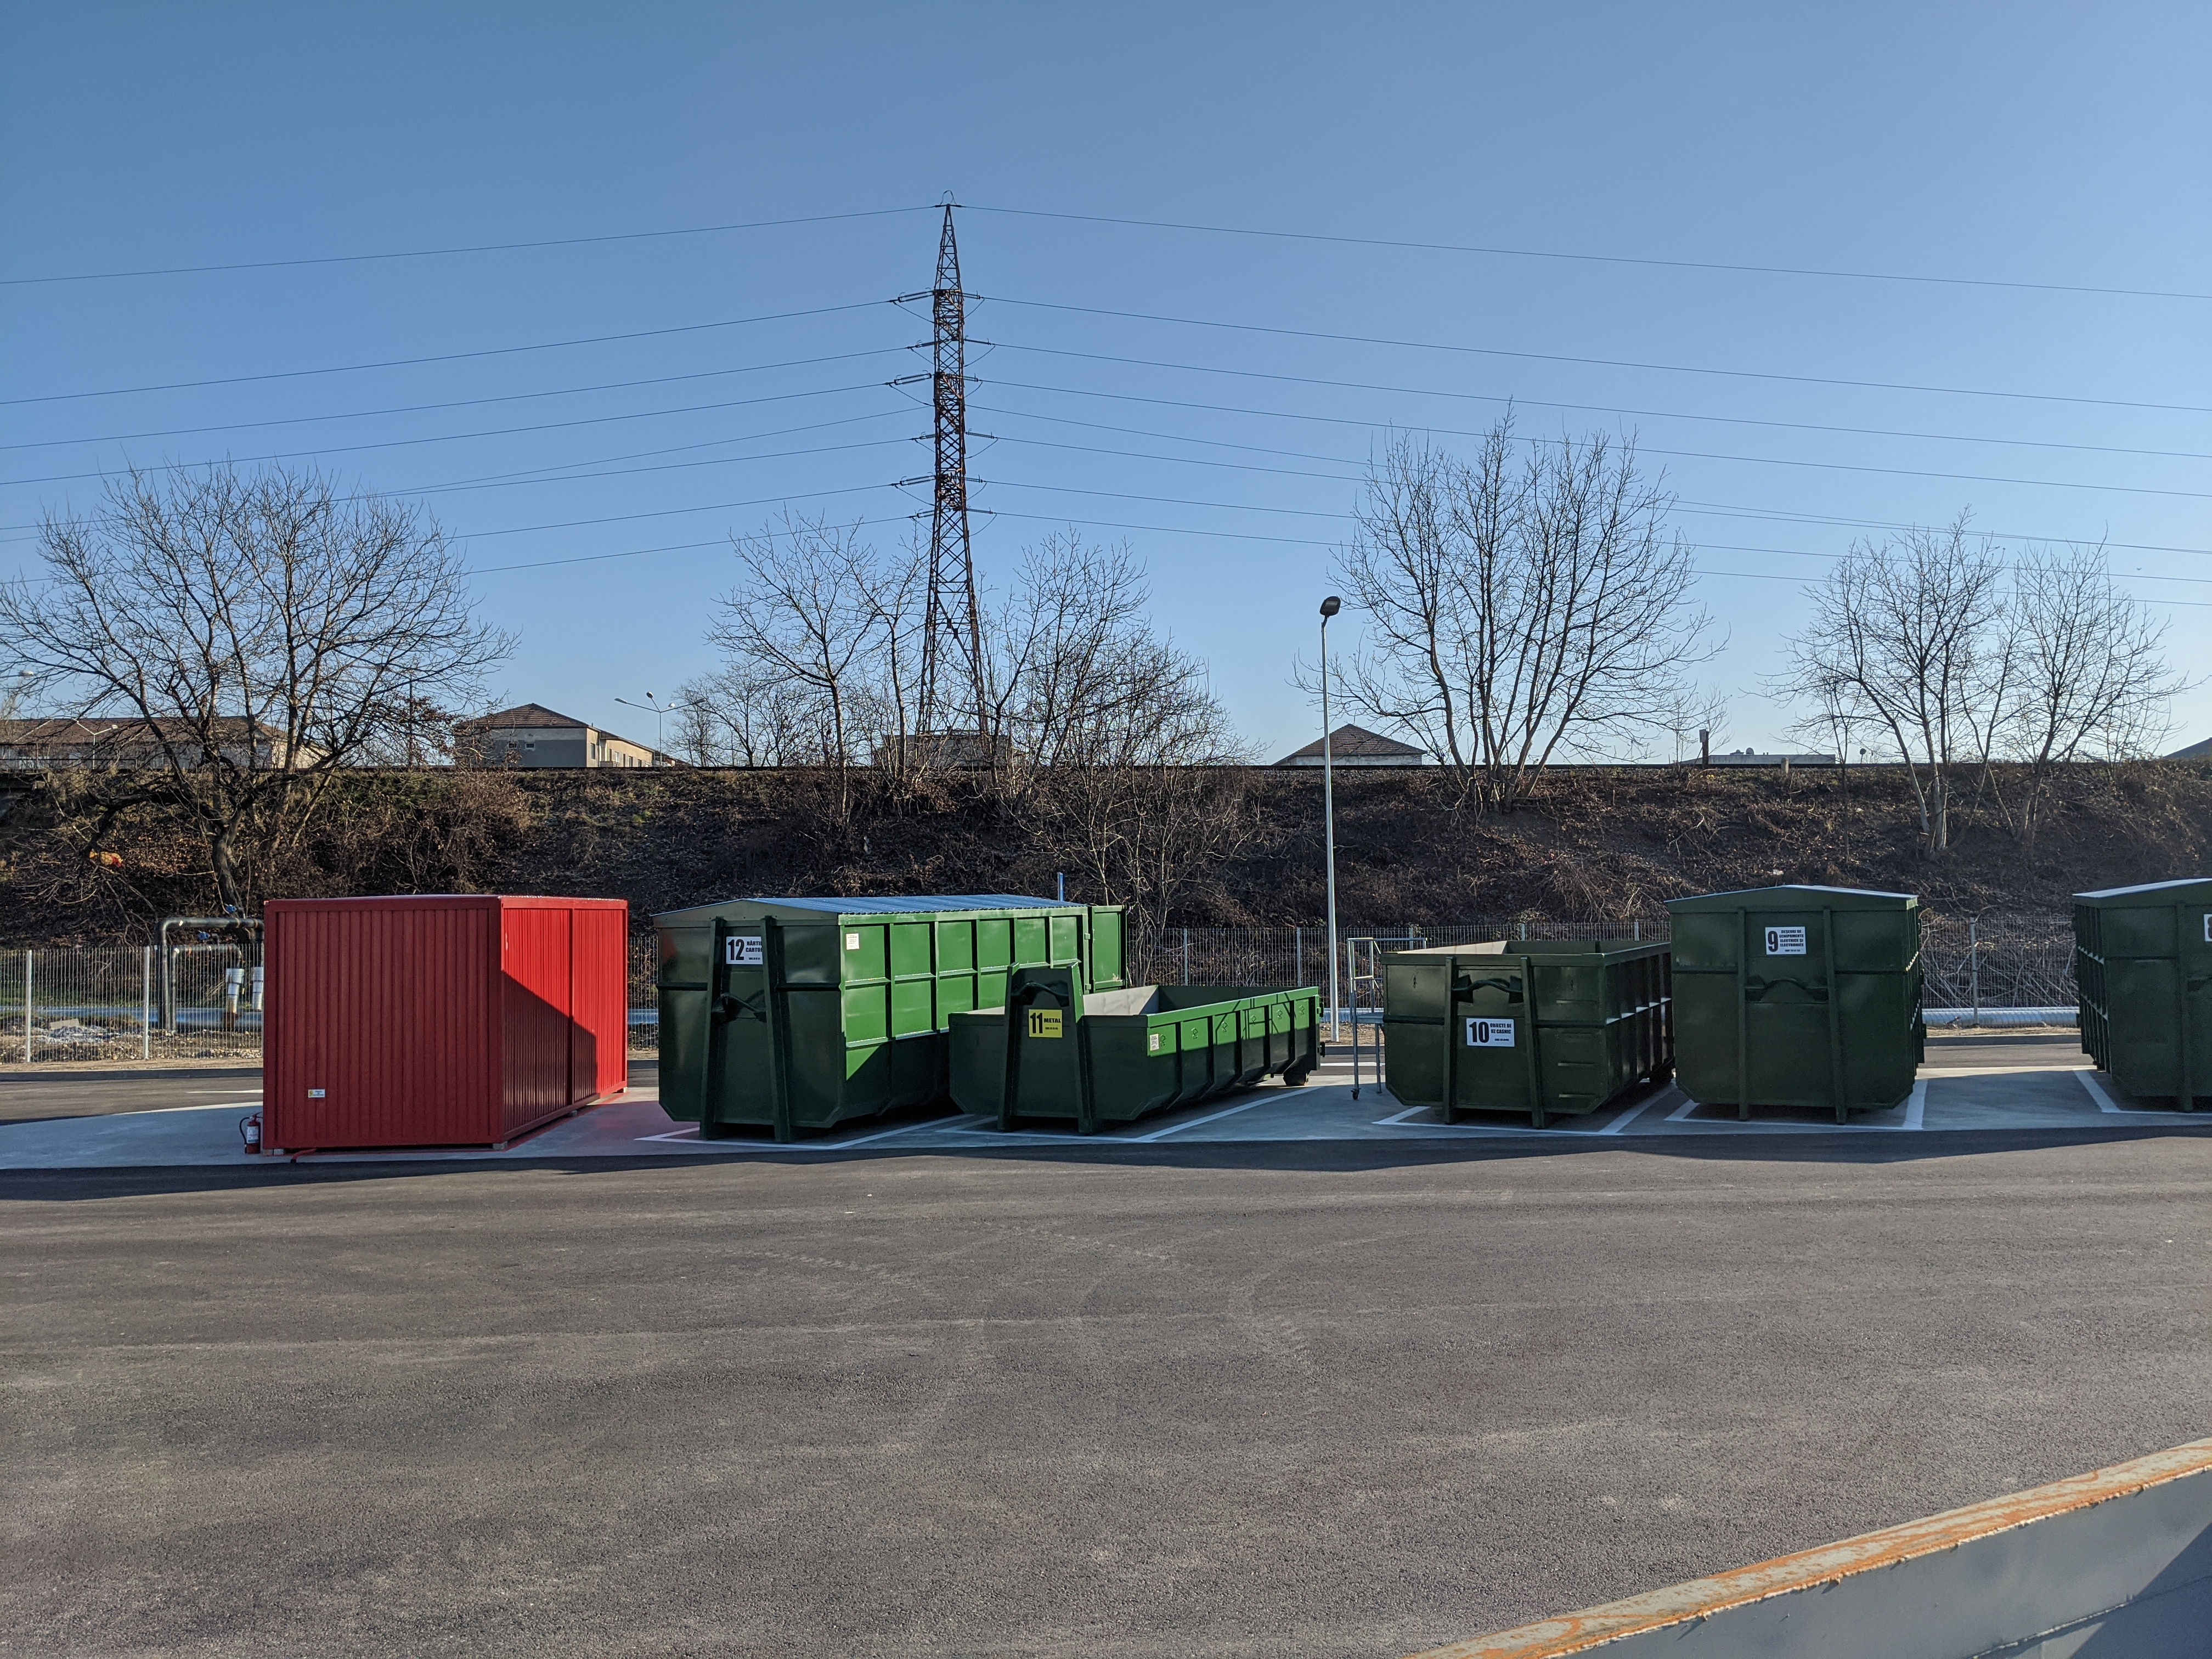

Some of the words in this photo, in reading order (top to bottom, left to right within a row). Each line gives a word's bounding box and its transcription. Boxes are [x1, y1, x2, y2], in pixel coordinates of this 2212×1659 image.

[727, 939, 744, 961] 12
[1768, 930, 1779, 952] 9
[1030, 1012, 1043, 1034] 11
[1469, 1022, 1489, 1043] 10
